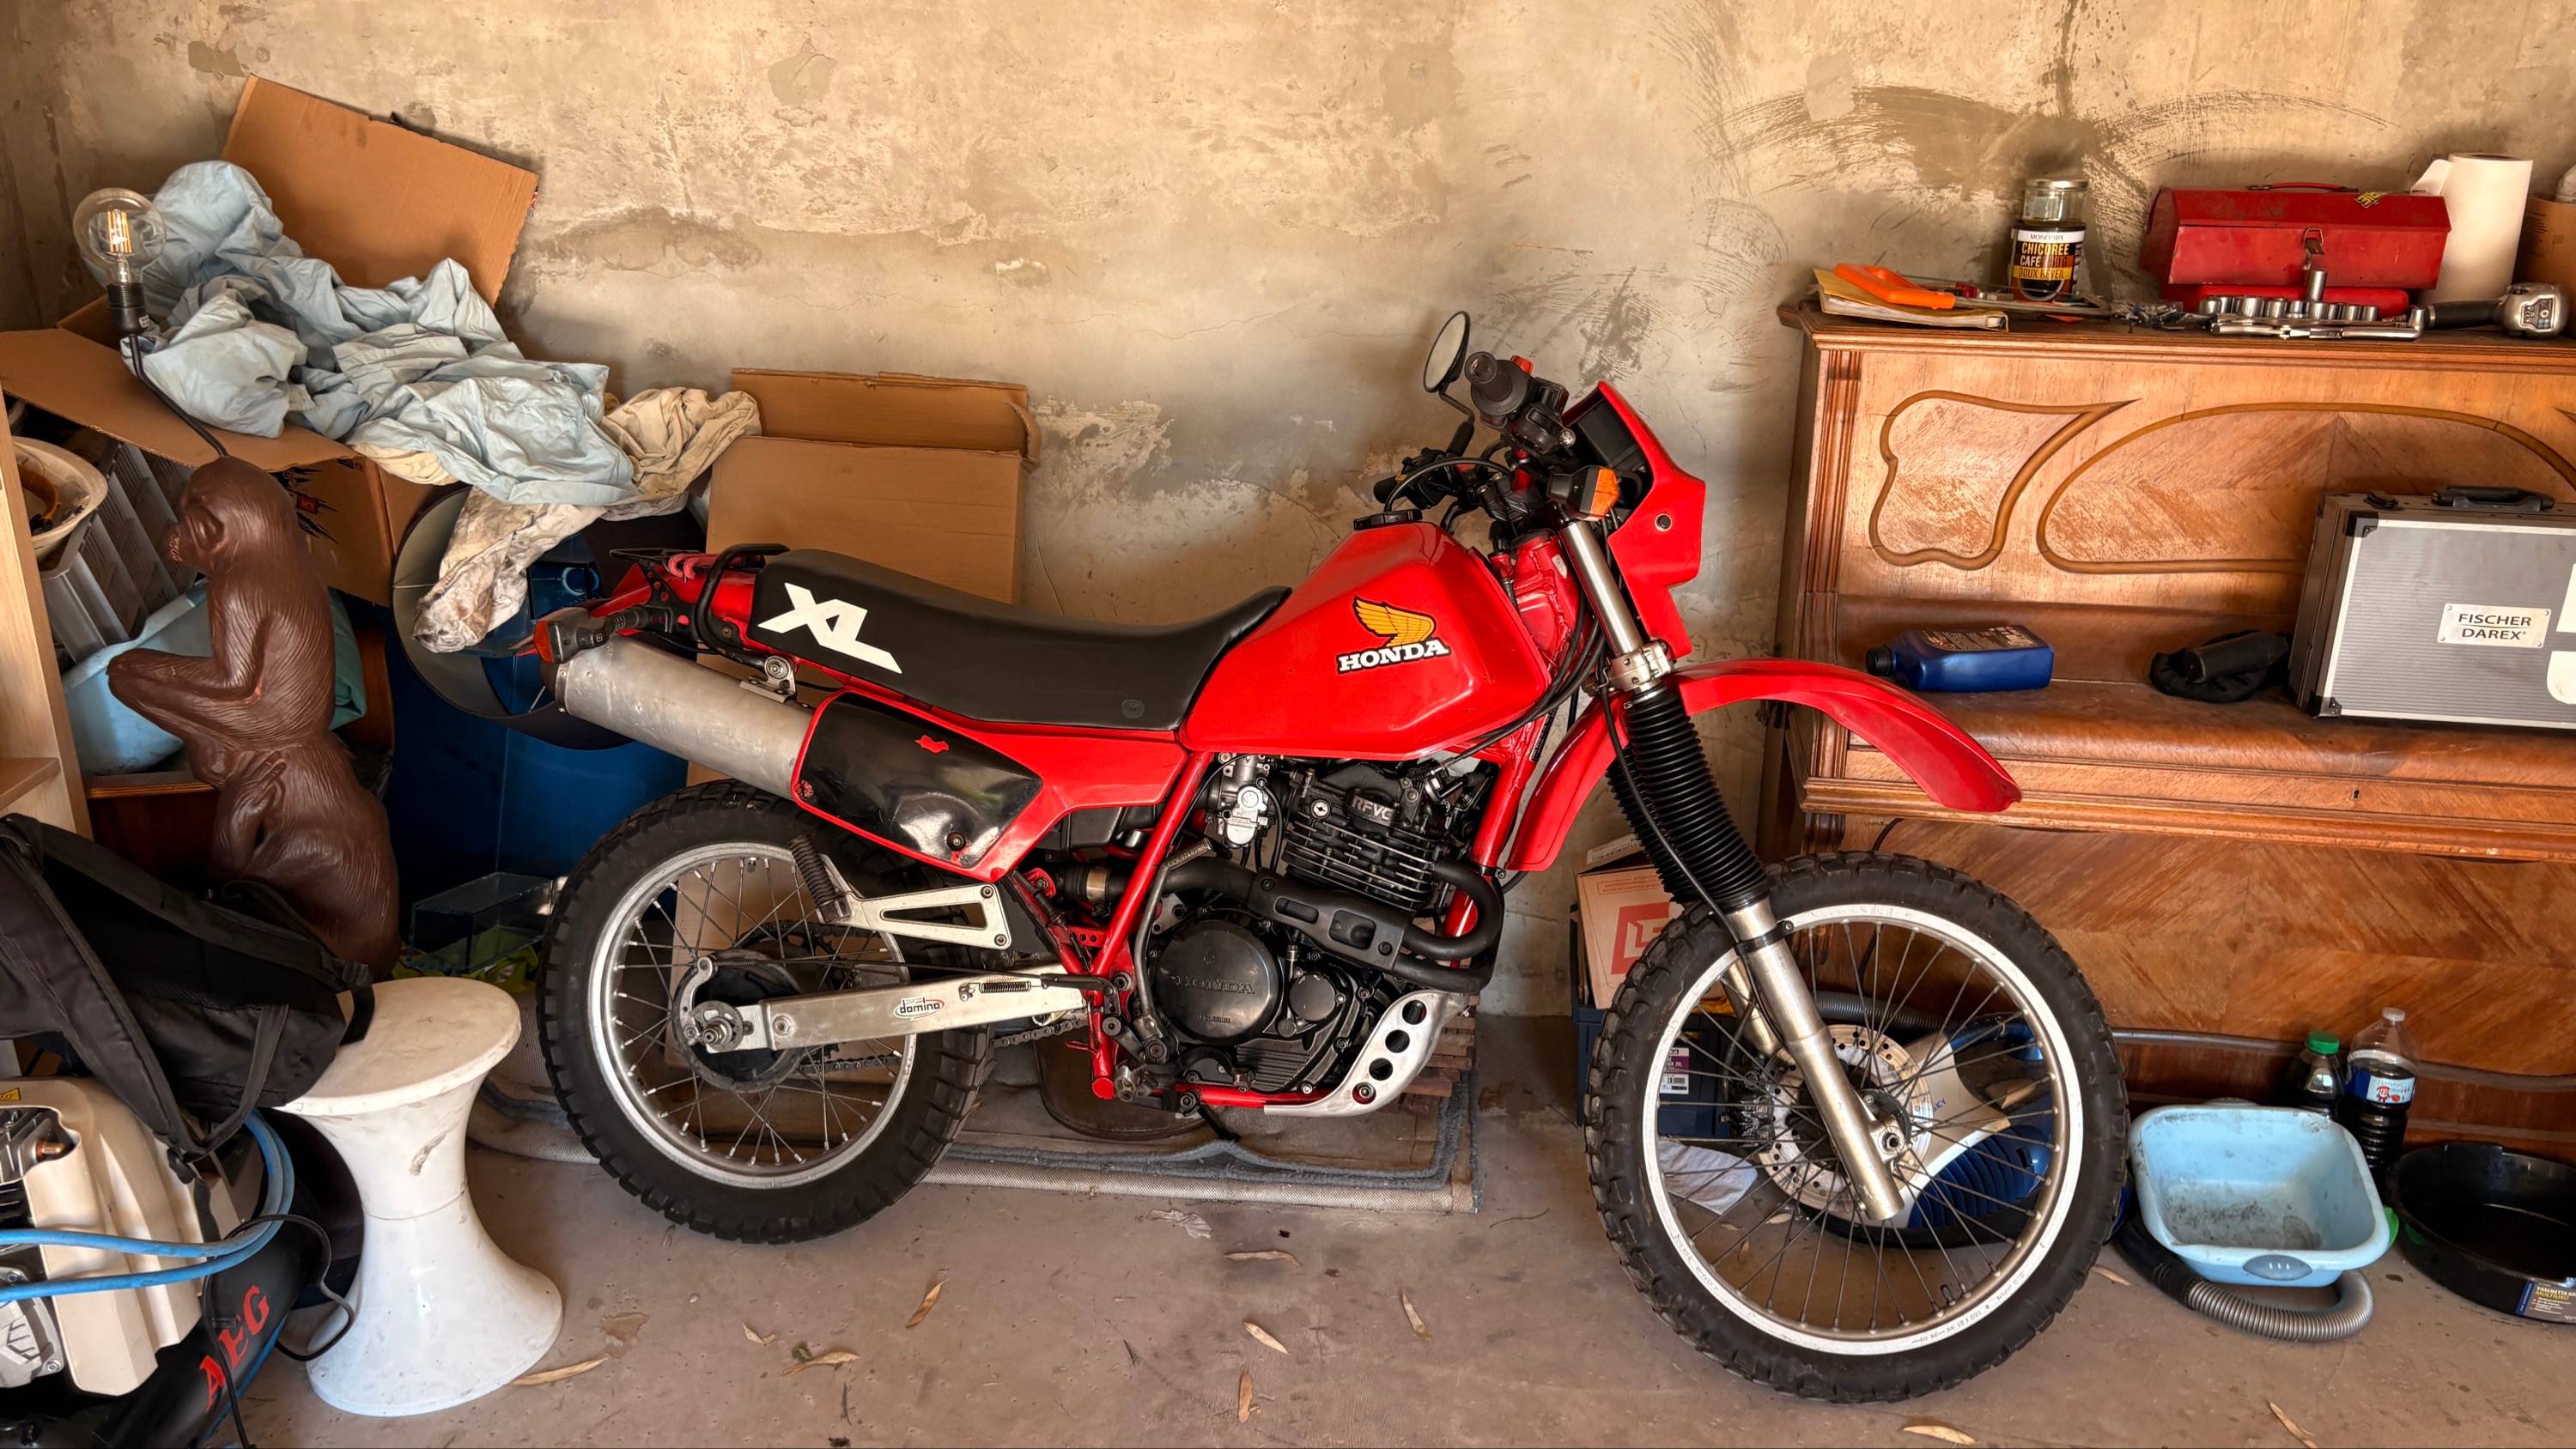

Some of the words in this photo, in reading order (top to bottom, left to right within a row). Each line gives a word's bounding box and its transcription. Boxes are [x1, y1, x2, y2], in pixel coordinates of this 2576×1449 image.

[2019, 267, 2038, 278] DOUX
[757, 582, 902, 674] XL
[2458, 613, 2532, 627] FISCHER
[1338, 640, 1450, 672] HONDA
[1352, 795, 1395, 822] RFVC
[1176, 975, 1255, 995] HONDA
[900, 997, 940, 1014] domino
[199, 1285, 270, 1412] AEG
